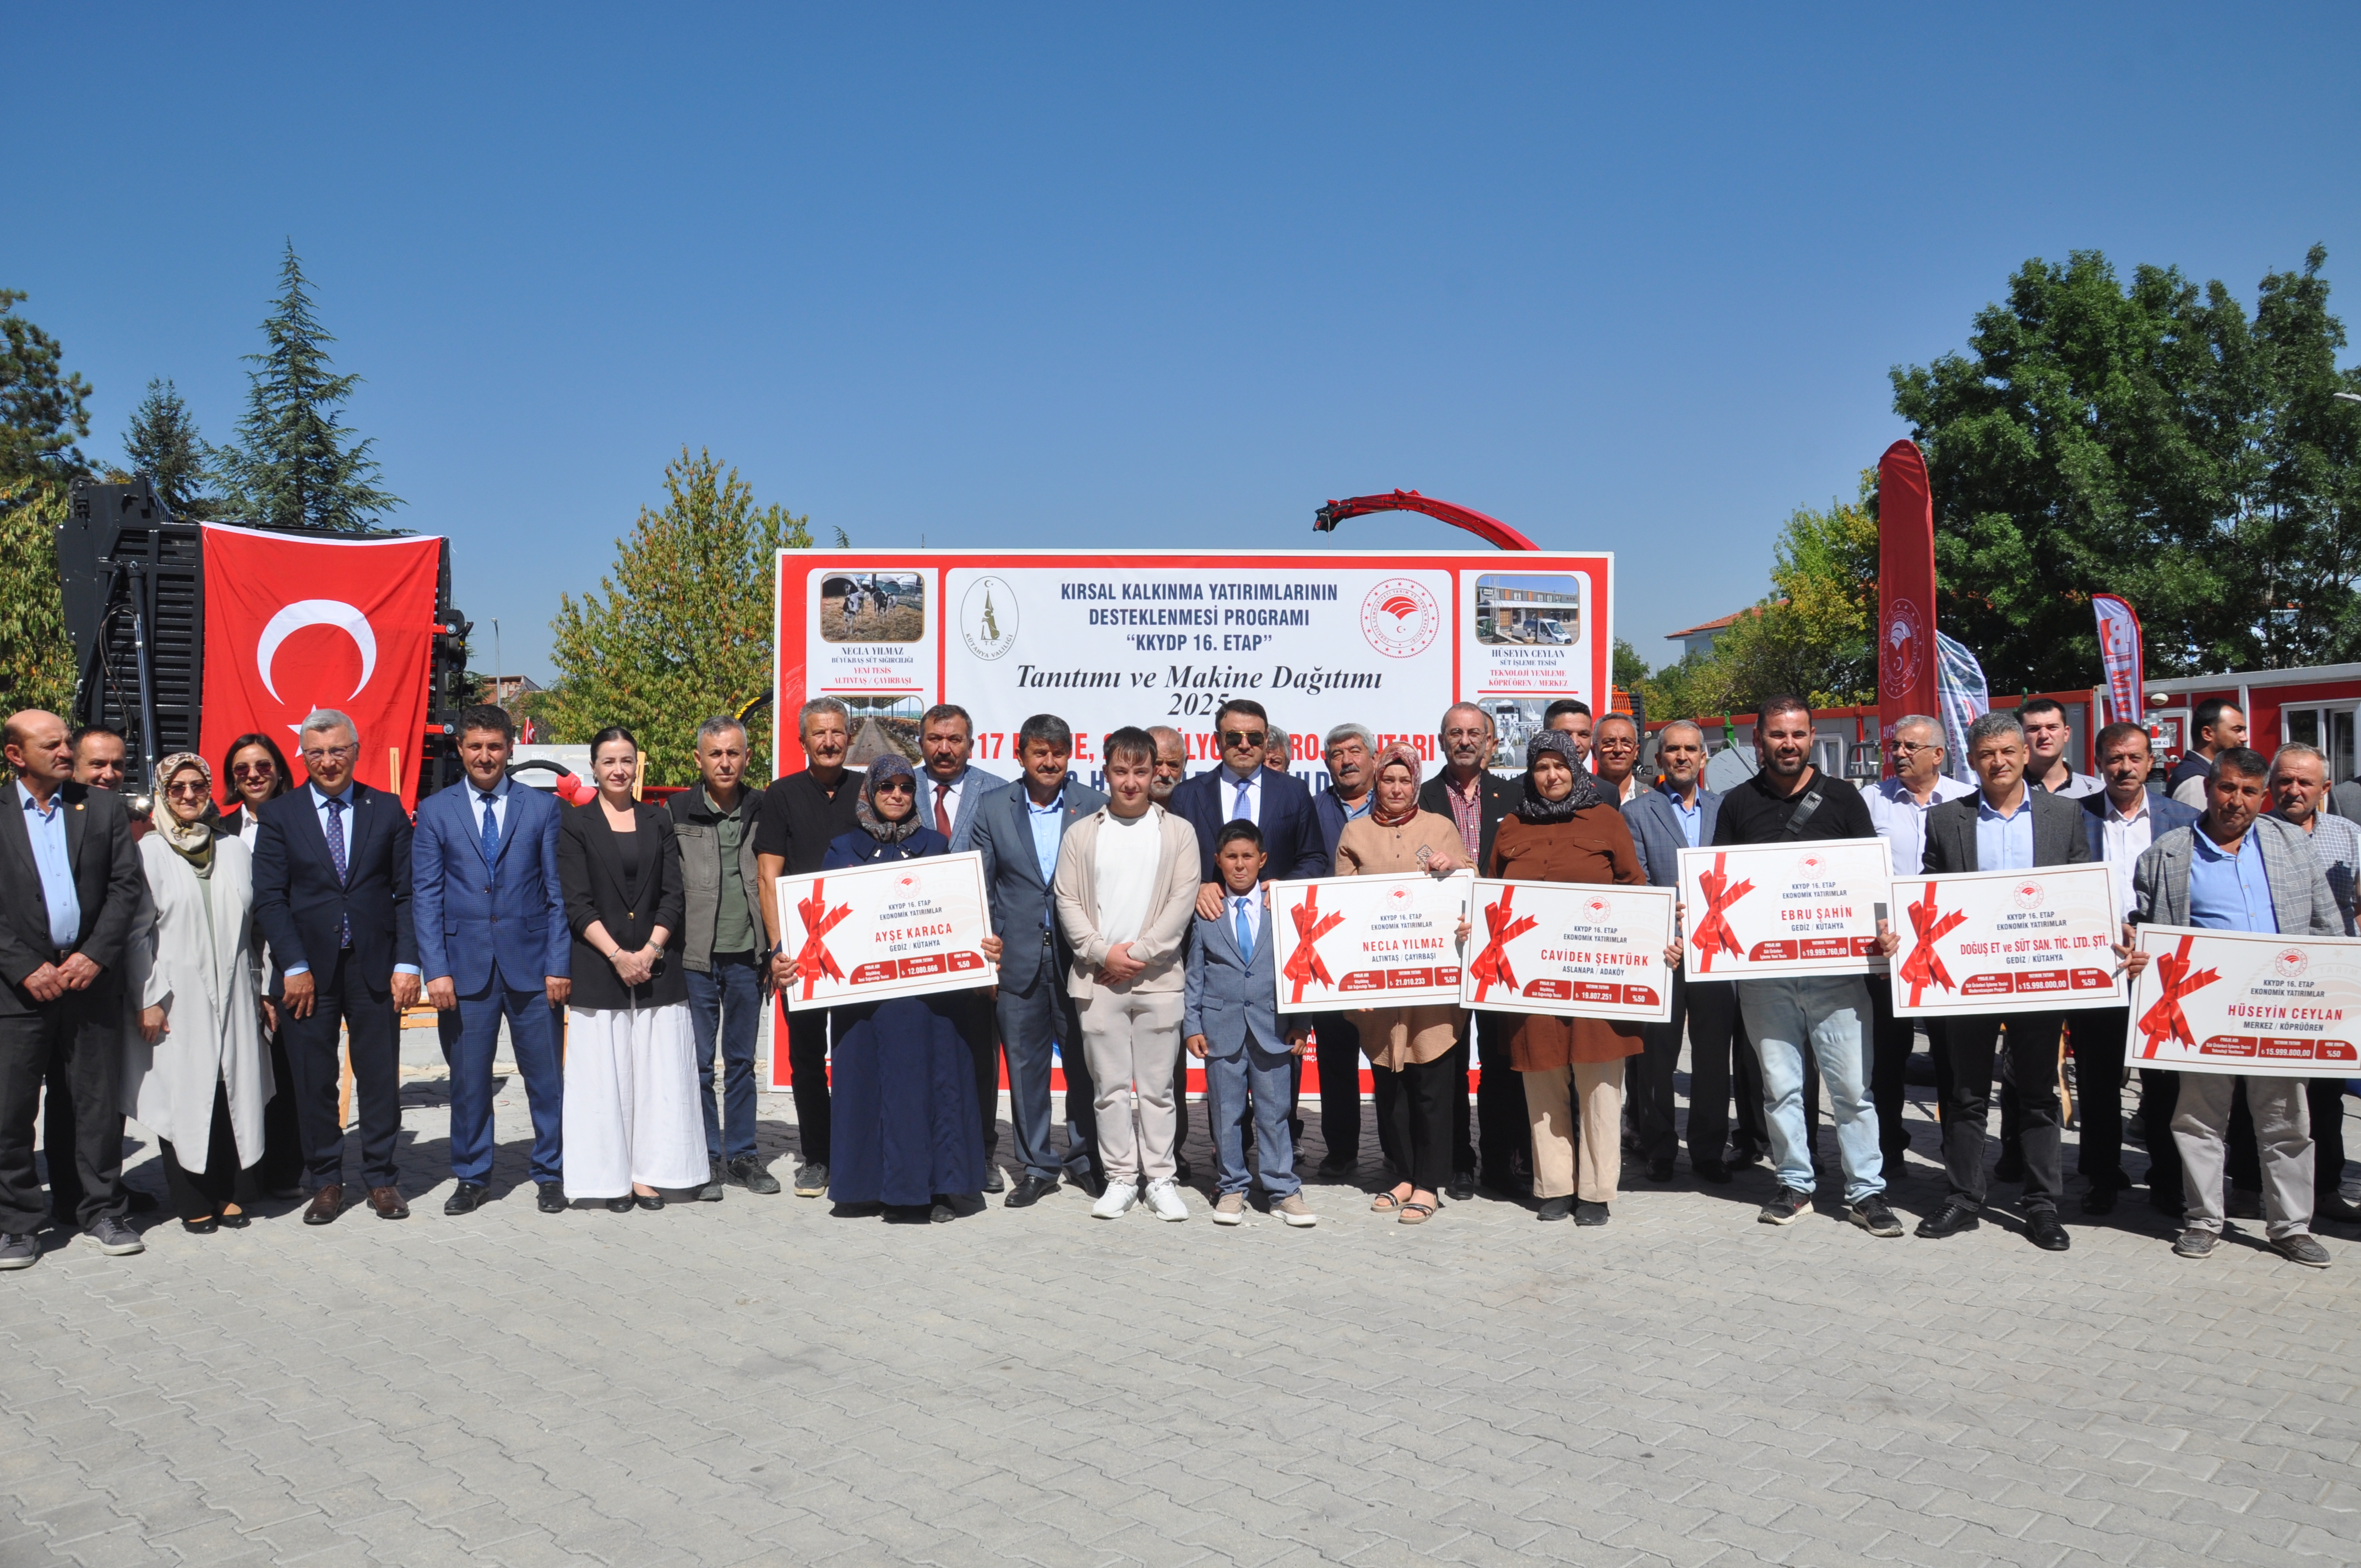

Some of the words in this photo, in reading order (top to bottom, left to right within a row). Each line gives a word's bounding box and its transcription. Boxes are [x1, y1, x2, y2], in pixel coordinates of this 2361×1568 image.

[1062, 583, 1116, 600] KIRSAL
[1122, 583, 1204, 600] KALKINMA
[1210, 584, 1337, 601] YATIRIMLARININ
[1417, 598, 1427, 617] ORMAN
[1090, 605, 1217, 625] DESTEKLENMESİ
[1225, 609, 1309, 625] PROGRAMI
[966, 633, 989, 658] KÜTAHYA
[991, 634, 1013, 657] VALİLİĞİ
[1194, 634, 1217, 651] 16.
[841, 647, 869, 655] NECLA
[872, 647, 904, 655] YILMAZ
[1492, 647, 1528, 657] HÜSEYİN
[1531, 650, 1565, 658] CEYLAN
[831, 656, 864, 665] BÜYÜKBAŞ
[854, 666, 870, 674] YENİ
[872, 666, 891, 674] TESİS
[1490, 668, 1528, 677] TEKNOLOJİ
[874, 677, 911, 685] ÇAYIRBAŞI
[1016, 665, 1121, 688] Tanıtımı
[1130, 672, 1157, 688] ve
[1163, 665, 1263, 688] Makine
[1270, 666, 1382, 695] Dağıtımı
[888, 902, 905, 911] KKYDP
[879, 911, 909, 921] EKONOMİK
[910, 907, 942, 916] YATIRIMLAR
[1781, 908, 1812, 921] EBRU
[1816, 905, 1852, 923] ŞAHİN
[1815, 921, 1844, 930] KÜTAHYA
[1996, 922, 2029, 930] EKONOMİK
[2030, 919, 2067, 928] YATIRIMLAR
[875, 929, 903, 944] AYŞE
[906, 923, 953, 939] KARACA
[1563, 933, 1593, 941] EKONOMİK
[1594, 935, 1628, 944] YATIRIMLAR
[889, 943, 907, 952] GEDİZ
[913, 939, 940, 949] KÜTAHYA
[1362, 940, 1399, 952] NECLA
[1402, 937, 1444, 950] YILMAZ
[1960, 941, 1988, 957] DOĞUŞ
[1990, 941, 2000, 954] ET
[2002, 944, 2012, 953] ve
[2014, 938, 2031, 952] SÜT
[2032, 939, 2053, 951] SAN.
[2054, 935, 2071, 950] TİC.
[2072, 936, 2091, 949] LTD.
[2092, 932, 2109, 950] ŞTİ.
[1372, 954, 1399, 963] ALTINTAŞ
[1405, 952, 1436, 962] ÇAYIRBAŞI
[1541, 948, 1591, 963] CAVİDEN
[1595, 952, 1649, 967] ŞENTÜRK
[1806, 947, 1847, 957] 19.999.760,00
[2006, 956, 2026, 965] GEDİZ
[2032, 953, 2064, 963] KÜTAHYA
[907, 964, 938, 975] 12.080.666
[956, 960, 970, 968] %50
[1562, 965, 1594, 974] ASLANAPA
[1600, 967, 1625, 976] ADAKÖY
[1395, 977, 1425, 986] 21.010.233
[1444, 975, 1456, 983] %50
[2022, 979, 2066, 990] 15.998.000,00
[2081, 978, 2096, 986] %50
[1581, 991, 1612, 1000] 19.807.251
[1631, 994, 1645, 1003] %50
[2250, 988, 2285, 996] EKONOMİK
[2287, 989, 2325, 998] YATIRIMLAR
[2228, 1003, 2287, 1019] HÜSEYİN
[2291, 1008, 2343, 1021] CEYLAN
[2243, 1021, 2273, 1030] MERKEZ
[2280, 1021, 2324, 1031] KÖPRÜÖREN
[2265, 1047, 2311, 1058] 15.999.800,00
[2326, 1049, 2341, 1058] %50
